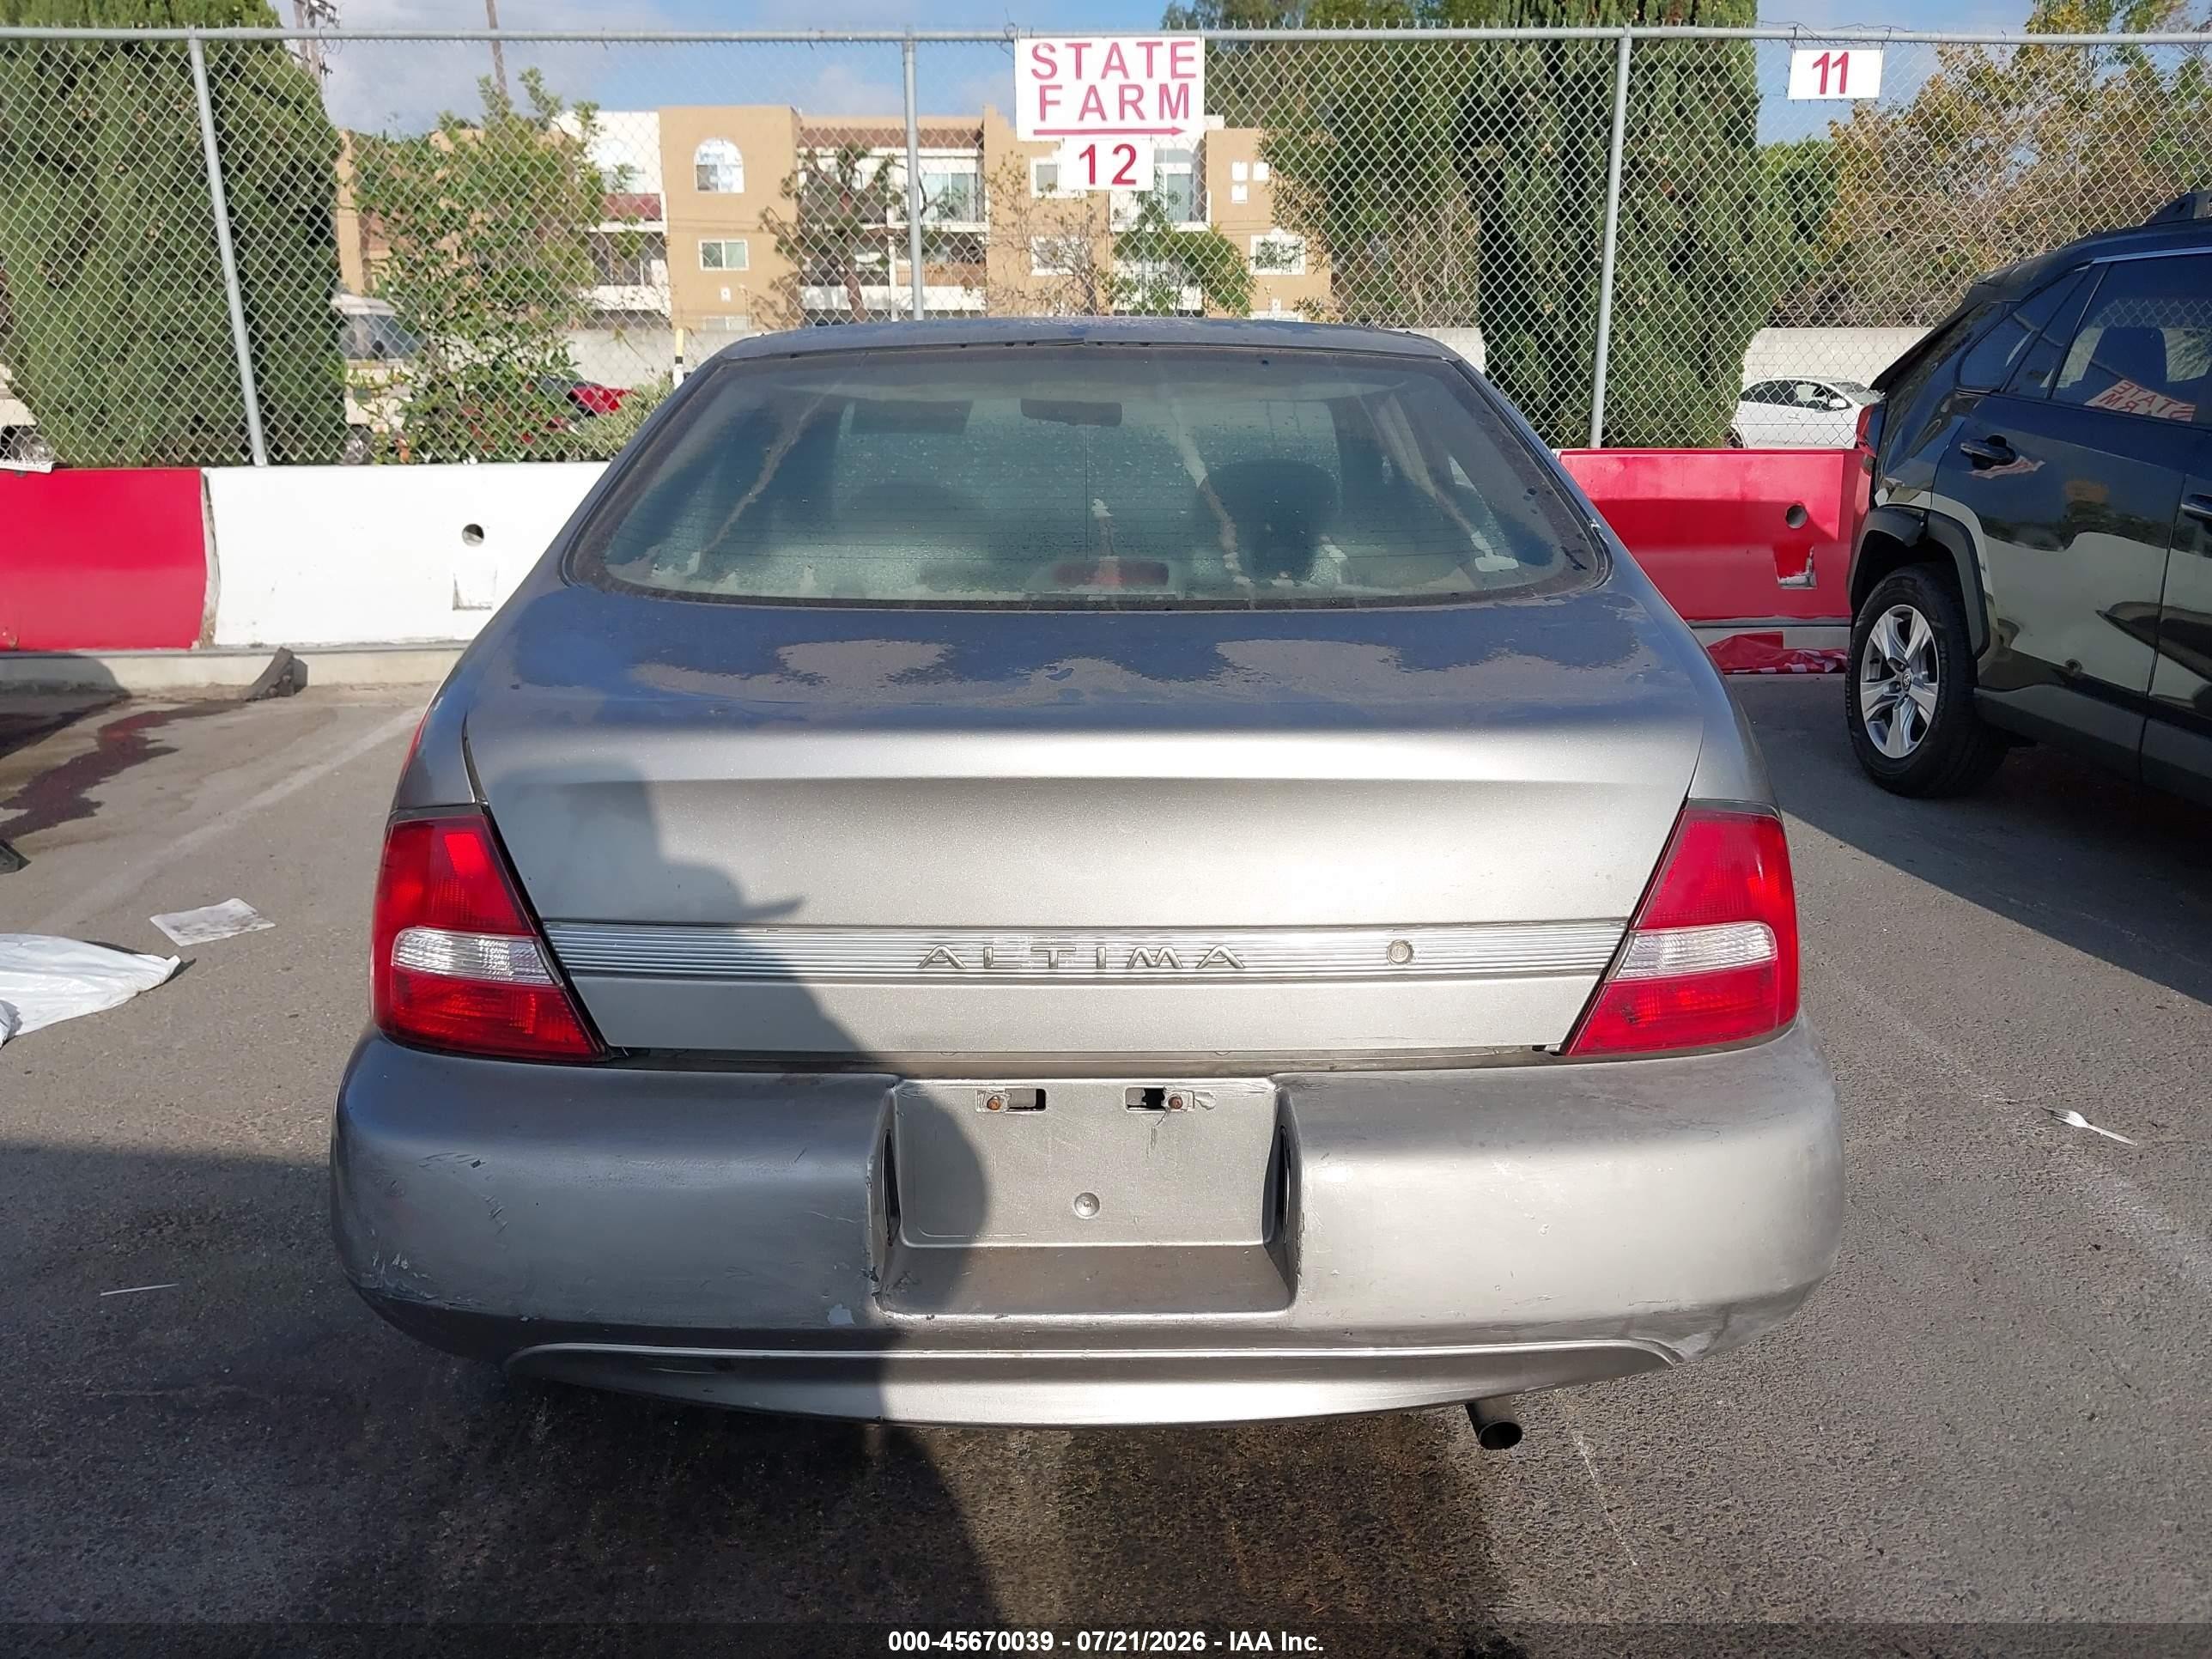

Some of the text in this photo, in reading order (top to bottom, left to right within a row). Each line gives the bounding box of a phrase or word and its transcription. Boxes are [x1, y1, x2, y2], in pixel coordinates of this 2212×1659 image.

[1031, 41, 1196, 80] STATE
[1812, 52, 1849, 94] 11
[1039, 83, 1189, 121] FARM
[1079, 143, 1137, 185] 12
[916, 945, 1247, 969] ALTIMA
